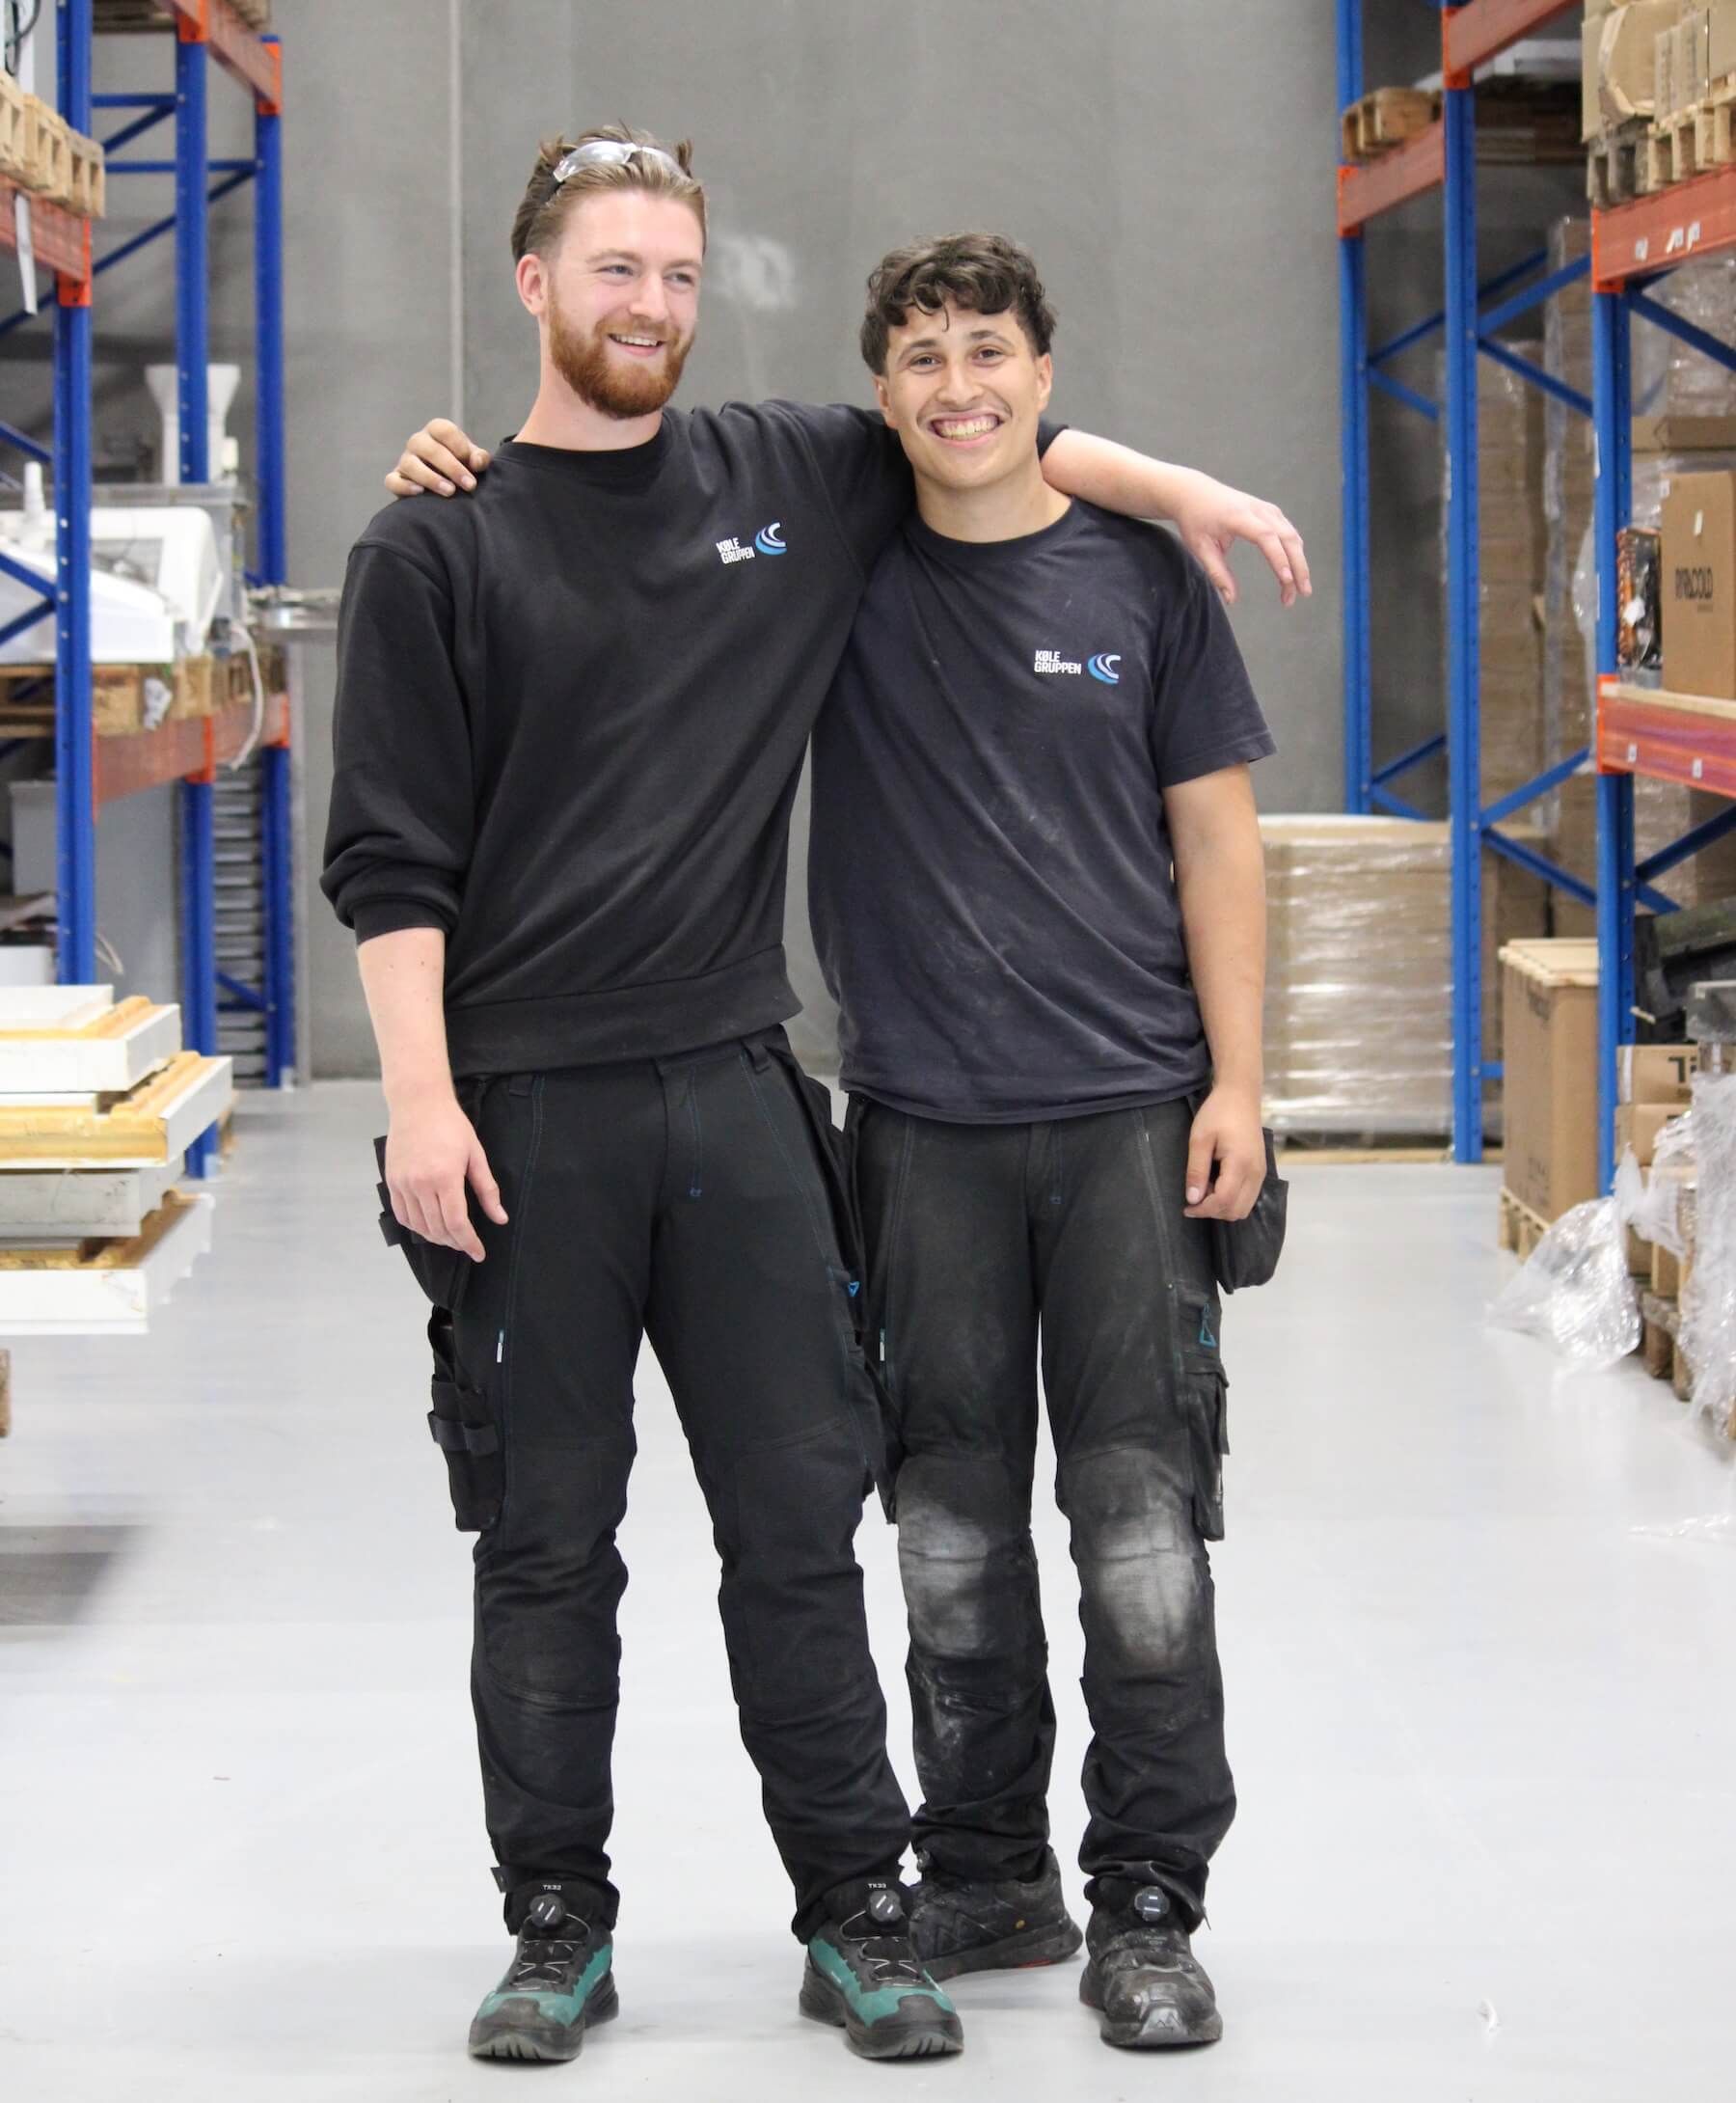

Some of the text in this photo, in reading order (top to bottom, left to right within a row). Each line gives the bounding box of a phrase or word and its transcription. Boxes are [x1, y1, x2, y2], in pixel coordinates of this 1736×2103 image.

[716, 537, 740, 554] KØLE
[720, 546, 756, 564] GRUPPEN
[1035, 649, 1061, 663] KØLE
[1034, 661, 1082, 675] GRUPPEN
